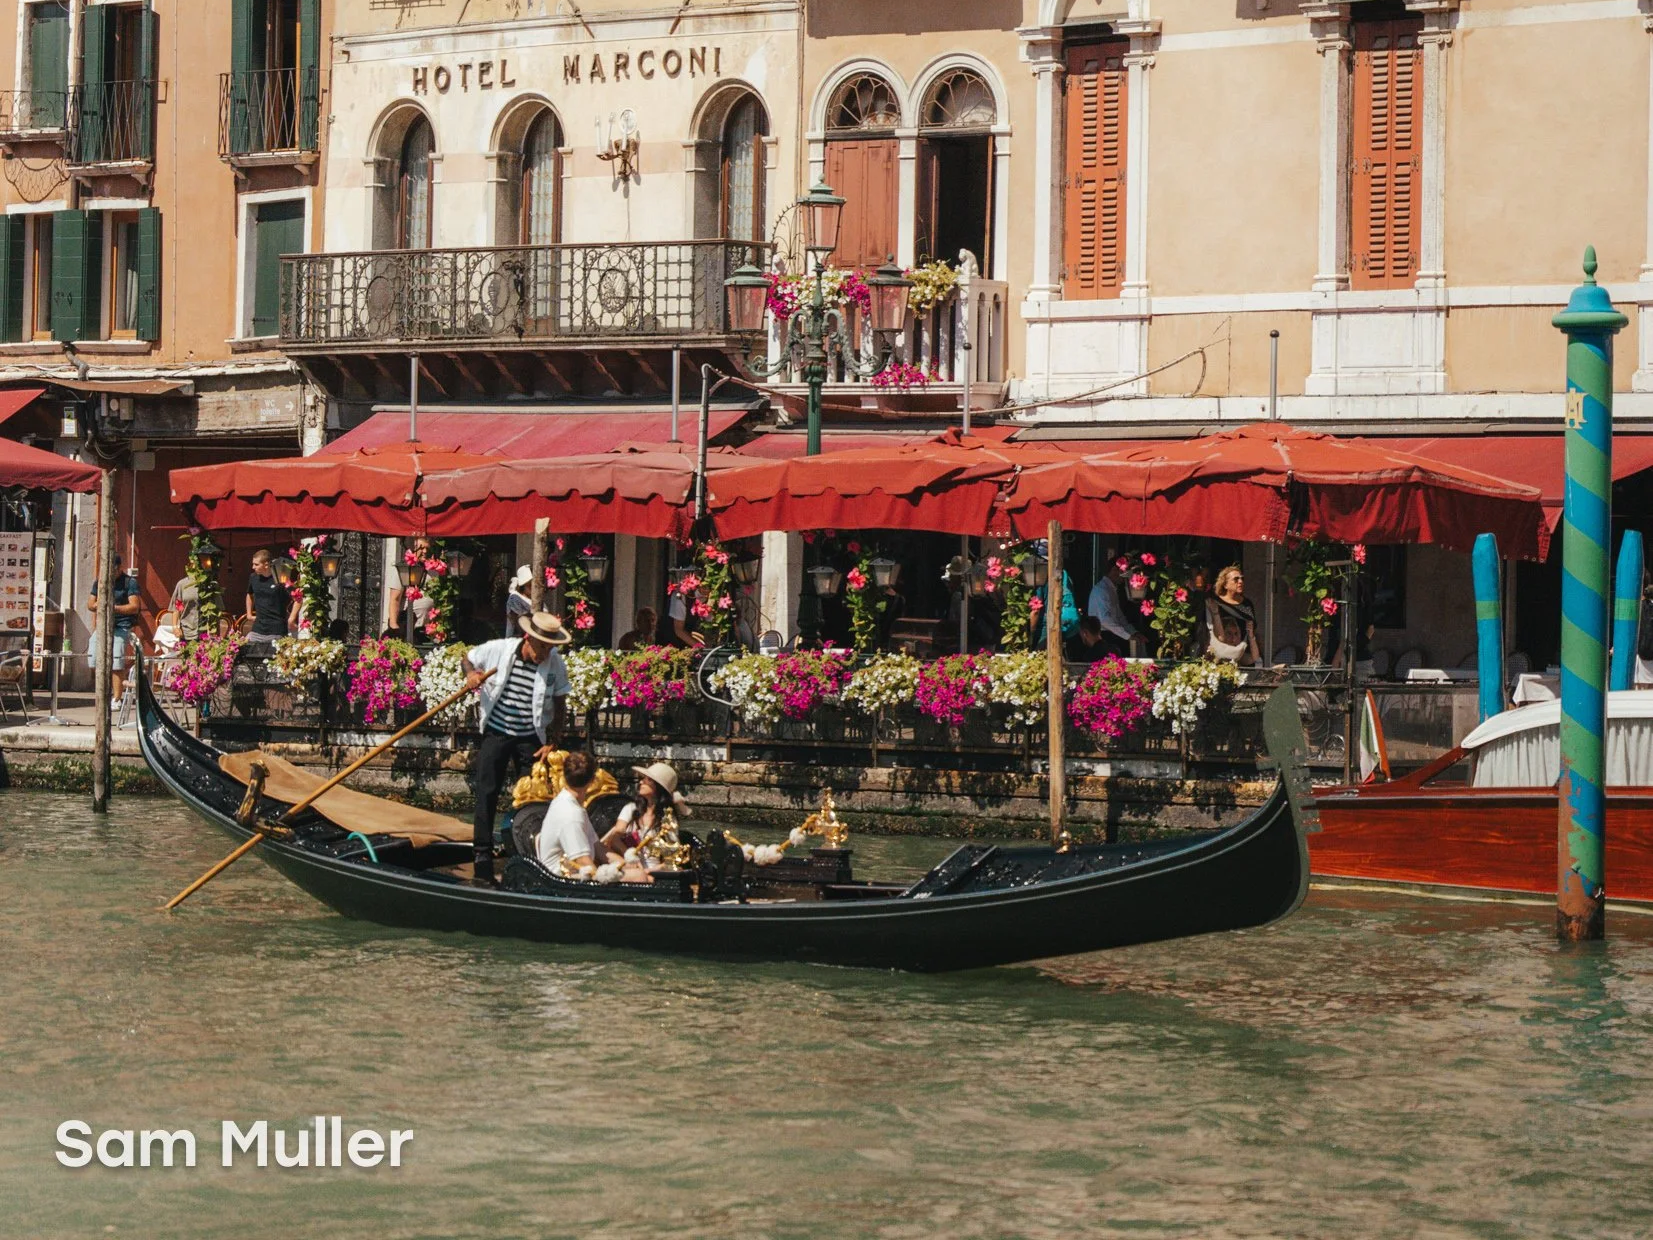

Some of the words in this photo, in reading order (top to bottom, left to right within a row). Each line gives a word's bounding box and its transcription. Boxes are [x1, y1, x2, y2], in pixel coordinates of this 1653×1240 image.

[412, 59, 516, 95] HOTEL
[563, 46, 721, 84] MARCONI
[264, 399, 276, 408] WC
